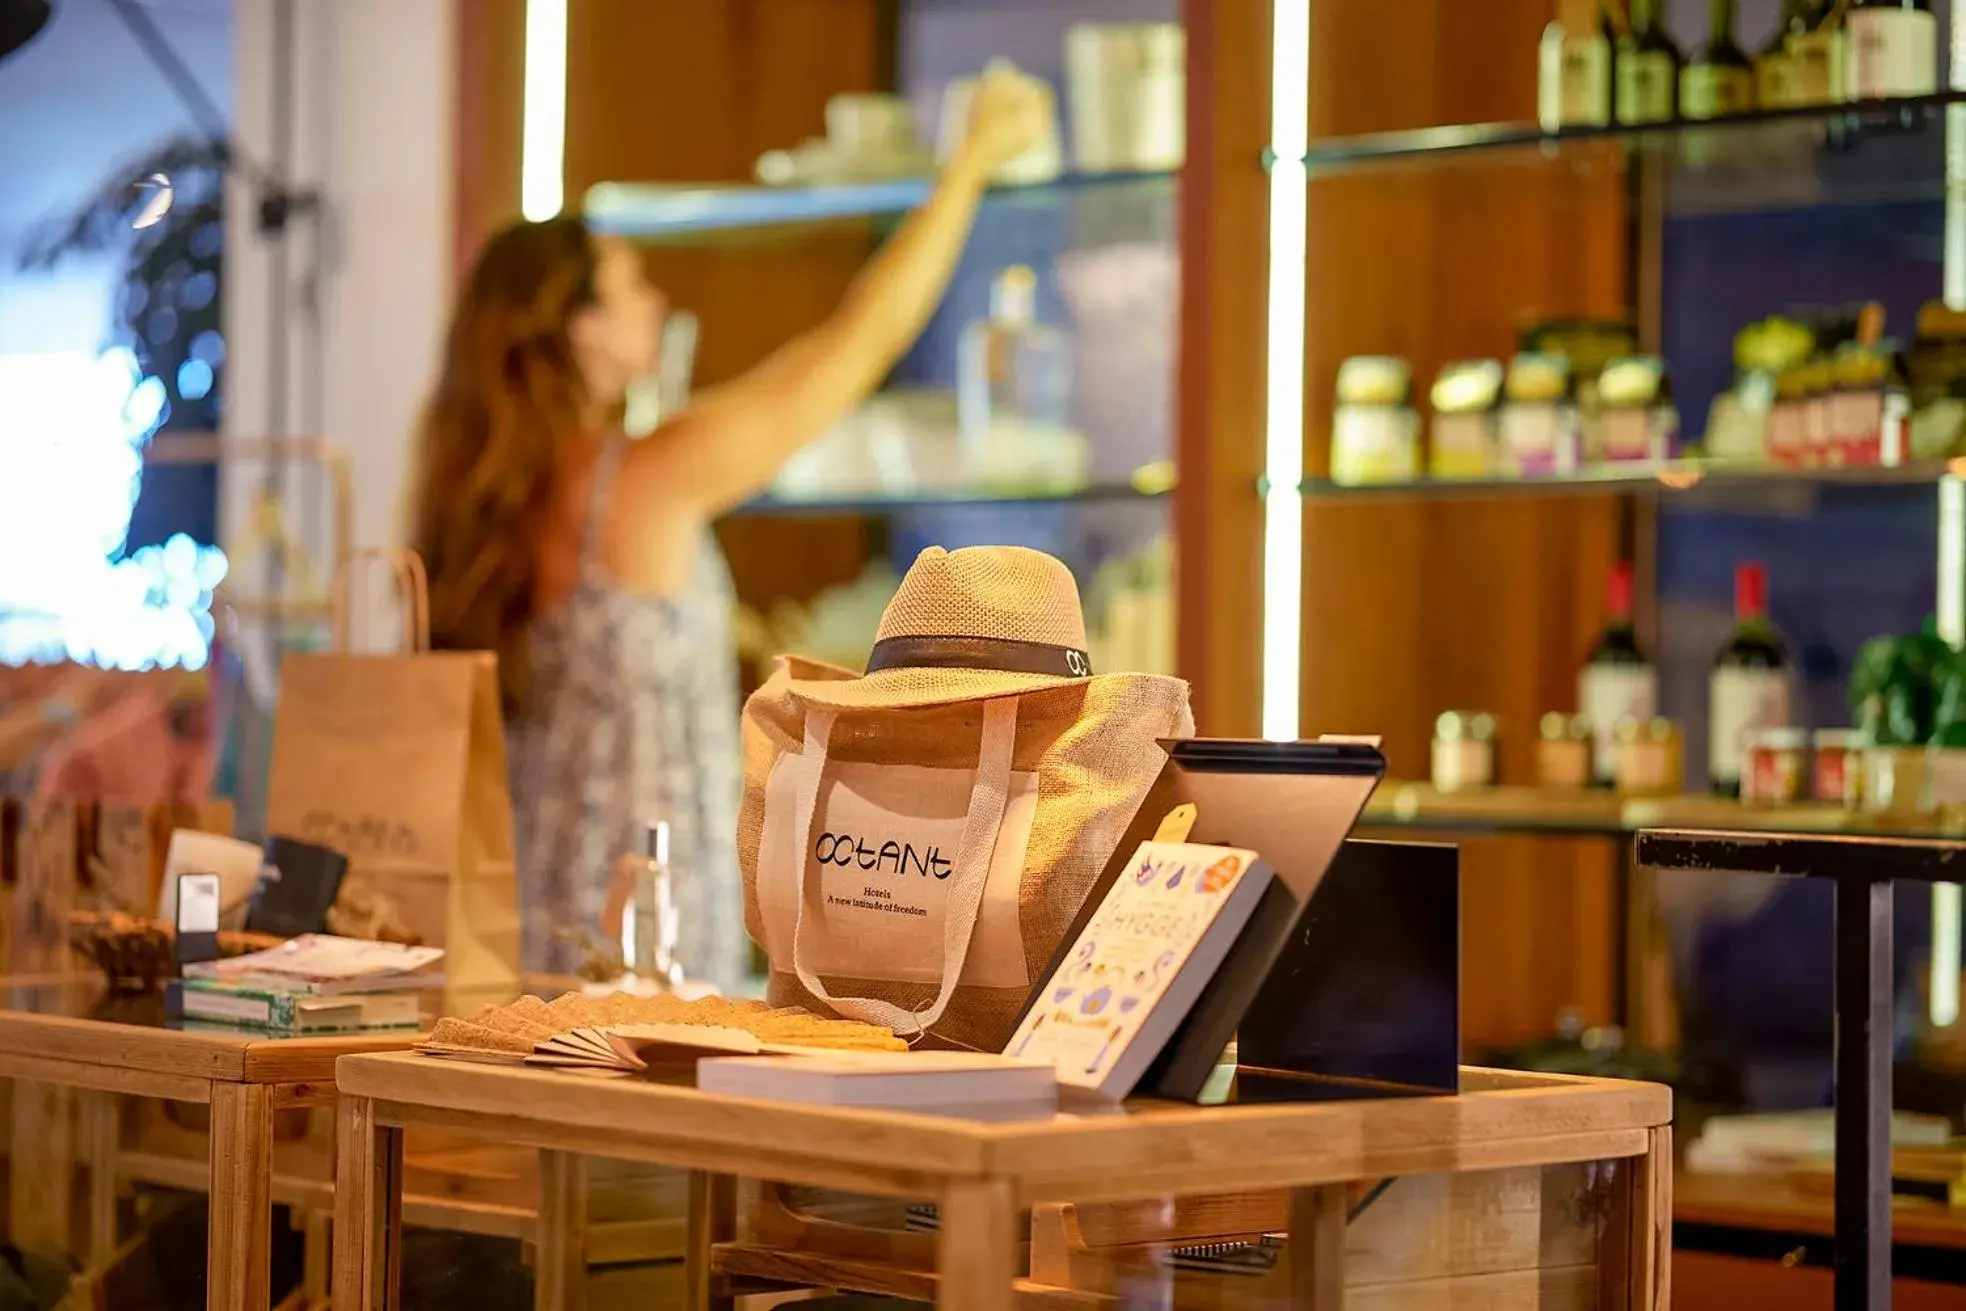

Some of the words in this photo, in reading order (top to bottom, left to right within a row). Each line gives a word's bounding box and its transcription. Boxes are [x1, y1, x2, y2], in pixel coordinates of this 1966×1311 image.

[863, 887, 891, 899] Hotels
[827, 895, 834, 904] A
[835, 897, 851, 906] new
[852, 898, 883, 911] latitude
[884, 902, 893, 912] of
[893, 903, 927, 916] freedom
